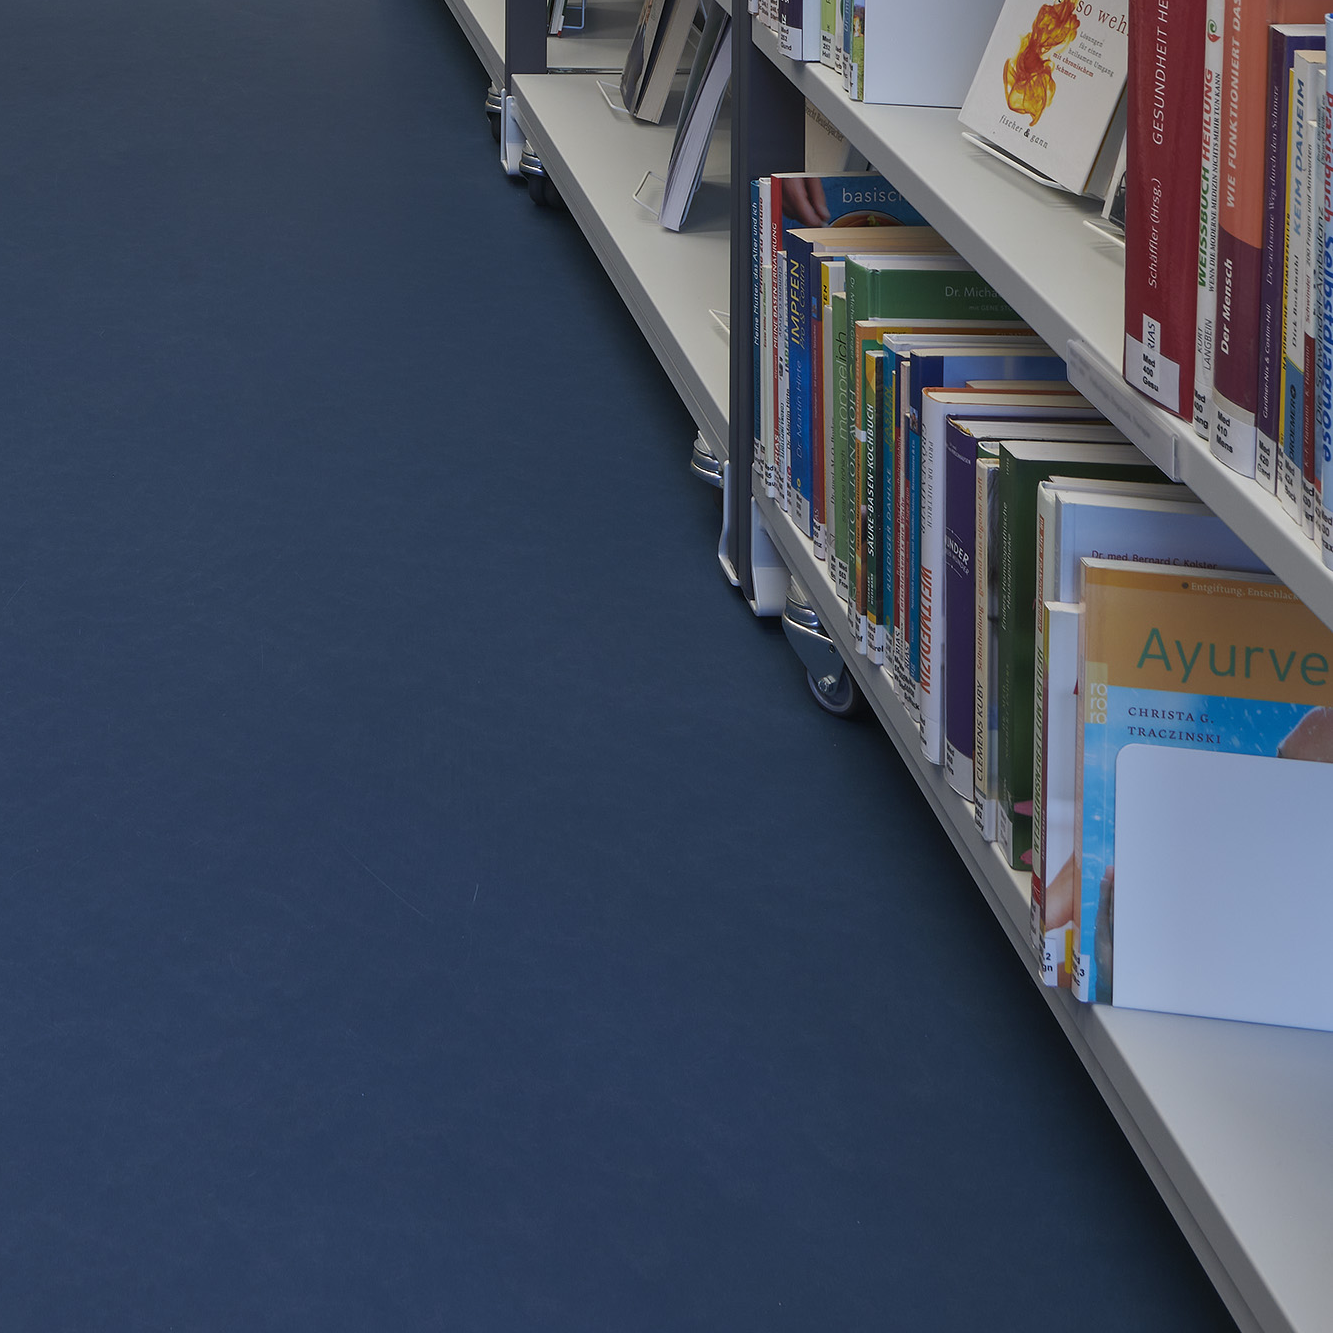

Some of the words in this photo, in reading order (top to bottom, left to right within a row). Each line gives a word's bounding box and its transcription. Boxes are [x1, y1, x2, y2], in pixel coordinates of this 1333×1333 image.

[1153, 26, 1170, 145] GESUNDHEIT
[1202, 67, 1214, 161] HEILUNG
[1198, 165, 1209, 288] WEISSBUCH
[790, 258, 800, 345] IMPFEN
[1222, 257, 1234, 320] Mensch
[1221, 324, 1231, 356] Der
[921, 564, 934, 696] WELTMEDIZIN
[1137, 627, 1330, 686] Ayurve
[1089, 682, 1107, 697] ro
[1089, 696, 1107, 711] ro
[1089, 710, 1107, 725] ro
[1128, 706, 1195, 722] CHRISTA
[1199, 711, 1214, 724] G.
[1128, 726, 1221, 744] TRACZINSKI
